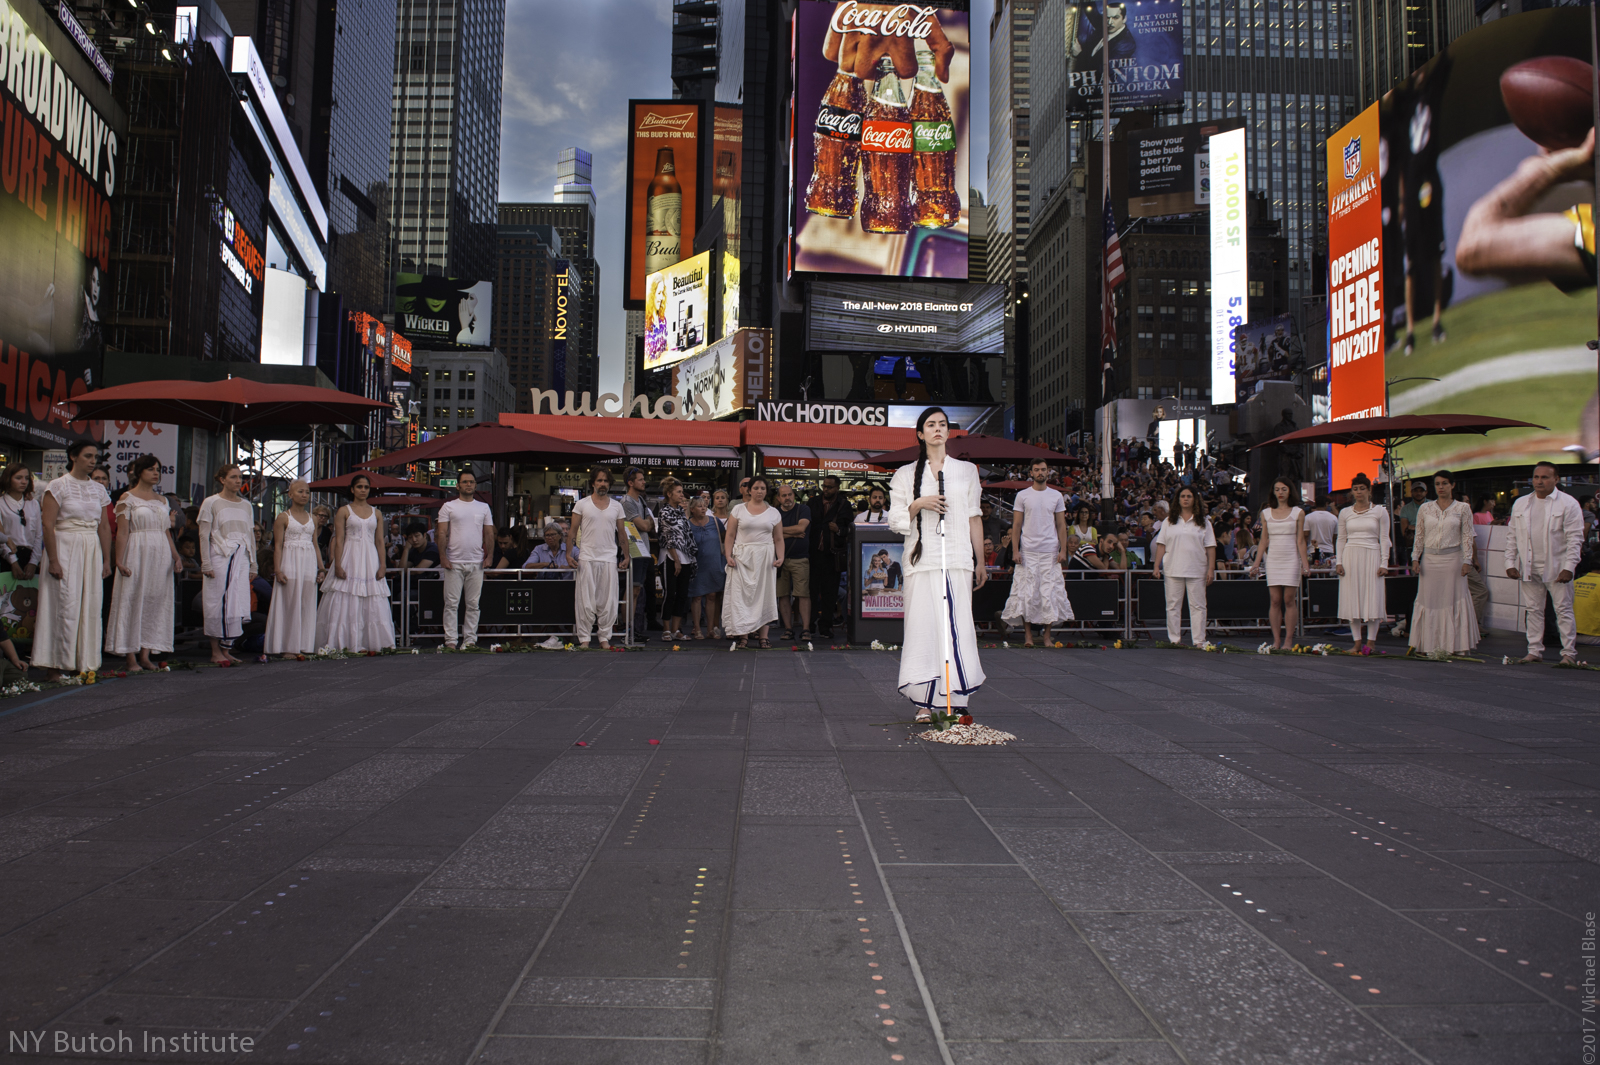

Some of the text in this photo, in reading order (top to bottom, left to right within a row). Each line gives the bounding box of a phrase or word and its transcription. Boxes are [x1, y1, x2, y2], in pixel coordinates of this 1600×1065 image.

[831, 1, 938, 40] Coca-Cola
[1133, 18, 1179, 28] FANTASIES
[1138, 26, 1174, 34] UNWIND
[61, 6, 112, 83] OUTFRONT PRIME
[1108, 58, 1138, 69] THE
[1068, 63, 1180, 88] PHANTOM
[0, 0, 117, 197] BROADWAY'S
[1078, 80, 1171, 97] OF THE OPERA
[644, 116, 688, 125] Budweiser
[817, 107, 862, 134] Coca-Col
[830, 130, 850, 140] zero
[861, 126, 912, 149] Coca-Cola
[914, 123, 953, 142] Coca-Cola
[1140, 136, 1184, 148] Show your
[1140, 145, 1184, 158] taste buds
[1147, 156, 1173, 166] berry
[1140, 164, 1182, 177] good time
[1346, 152, 1360, 174] NFL
[0, 92, 51, 222] URE
[55, 150, 112, 274] THING
[1224, 152, 1240, 247] 10,000 SF
[1331, 171, 1377, 216] EXPERIENCE
[1338, 194, 1370, 218] TIMES SQUARE
[234, 221, 264, 282] REQUEST
[646, 240, 680, 256] Bud
[1331, 237, 1380, 288] OPENING
[672, 267, 703, 290] Beautiful
[554, 268, 569, 340] NOVOTEL
[842, 301, 973, 312] The All-New 2018 Elantra GT
[1332, 270, 1380, 339] HERE
[894, 325, 938, 333] HYUNDAI
[394, 344, 410, 362] PLAZA
[1216, 337, 1224, 370] SIGNAGE
[748, 332, 764, 404] HELLO!
[52, 406, 60, 416] THE
[530, 381, 715, 422] nuchas
[758, 402, 886, 426] NYC HOTDOGS
[117, 440, 140, 449] NYC
[697, 459, 717, 467] DRINKS
[720, 460, 740, 468] COFFEE
[778, 458, 869, 470] WINE HOTDOGS
[864, 595, 904, 608] WAITRESS
